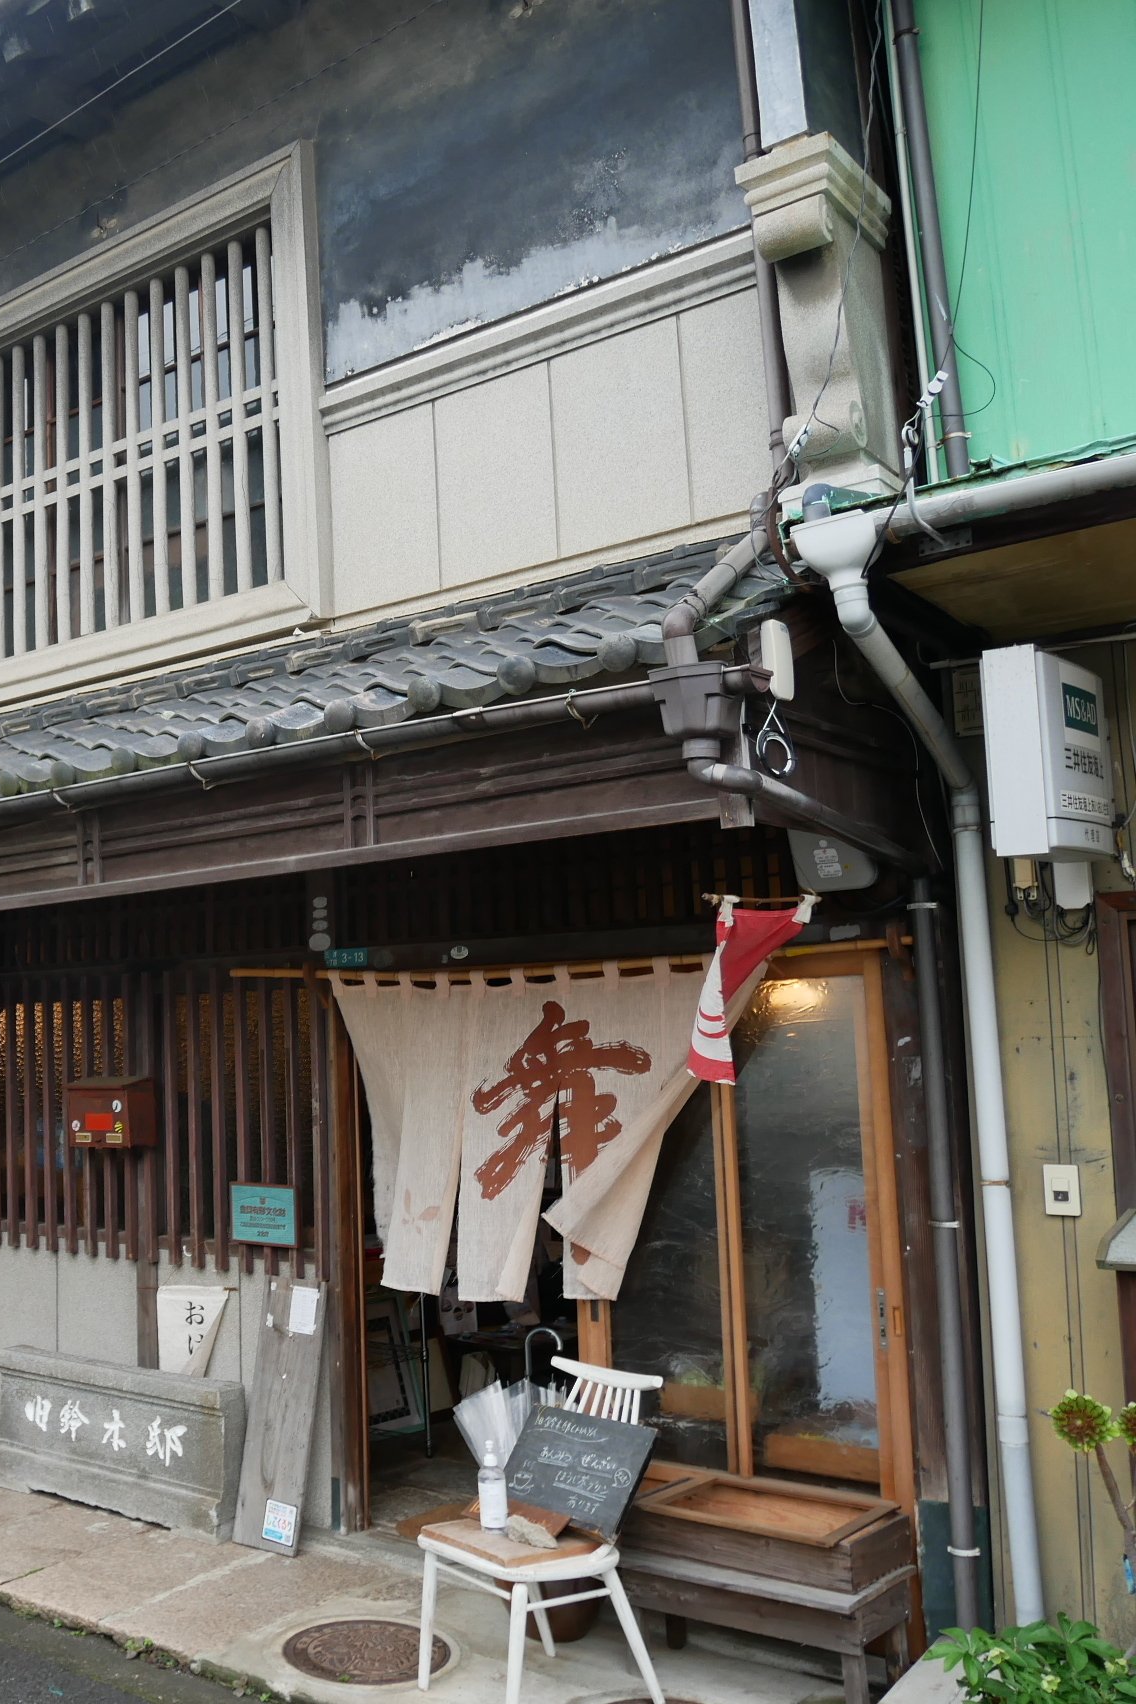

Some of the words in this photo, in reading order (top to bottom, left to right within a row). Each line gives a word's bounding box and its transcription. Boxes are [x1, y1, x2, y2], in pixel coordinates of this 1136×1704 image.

[1065, 694, 1097, 726] MS&AD
[1064, 748, 1104, 779] 三井住友海上
[341, 951, 364, 964] 3-13
[24, 1395, 188, 1467] 旧鈴木邸
